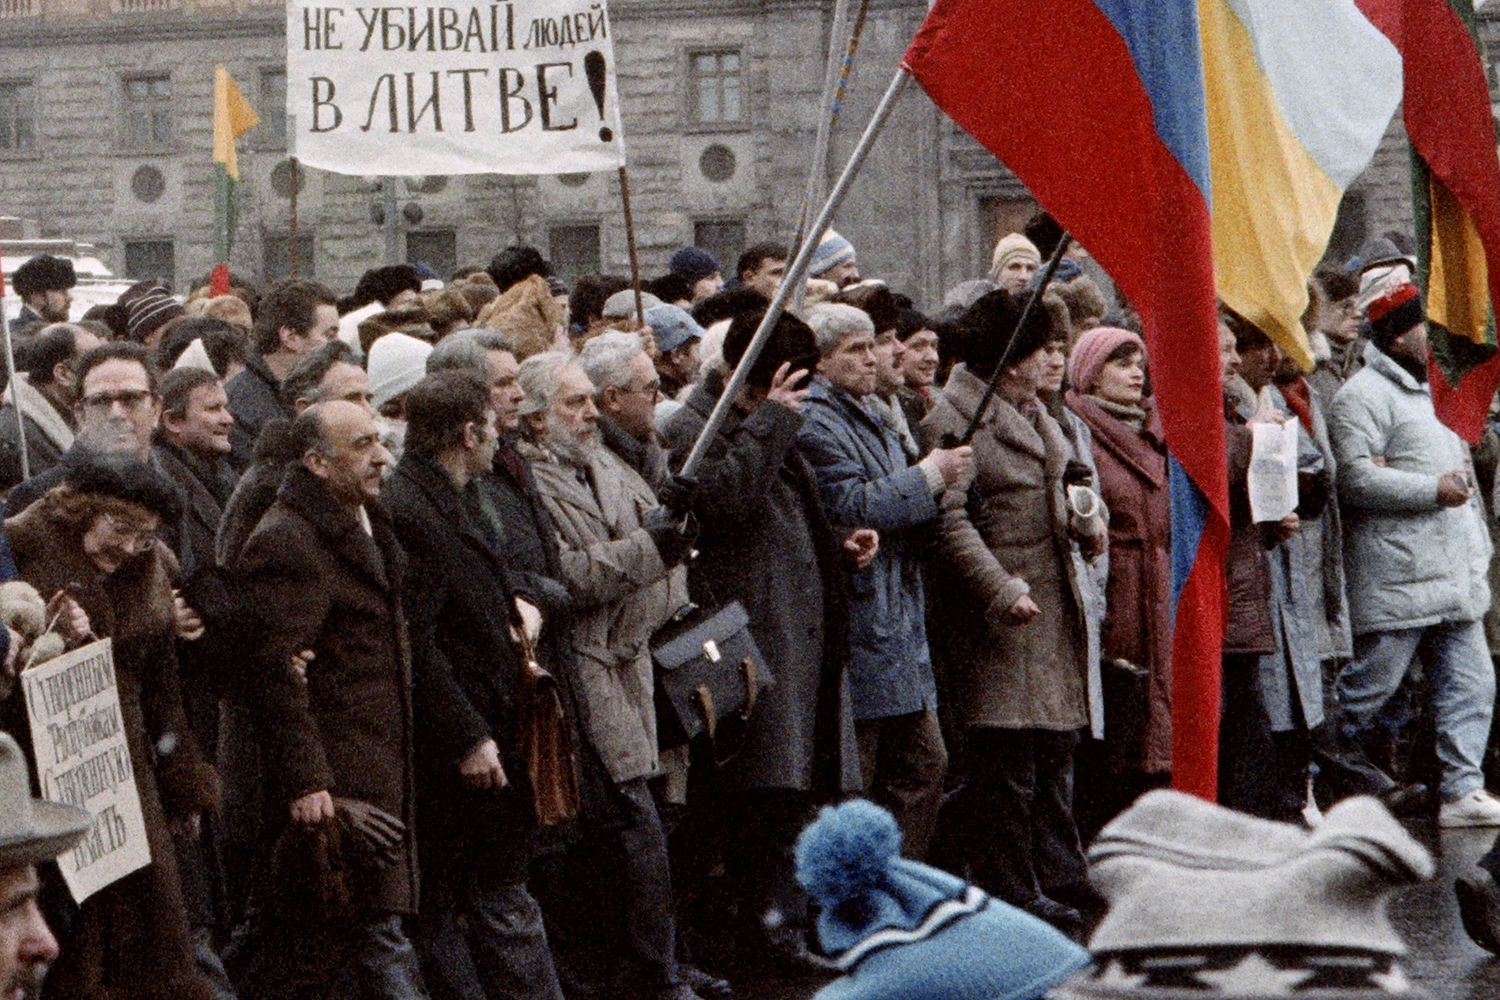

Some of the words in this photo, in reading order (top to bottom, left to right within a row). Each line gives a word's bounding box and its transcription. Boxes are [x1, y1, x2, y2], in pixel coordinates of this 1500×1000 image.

[302, 6, 345, 51] НЕ
[309, 75, 344, 133] В
[360, 50, 613, 143] ЛИТВЕ!
